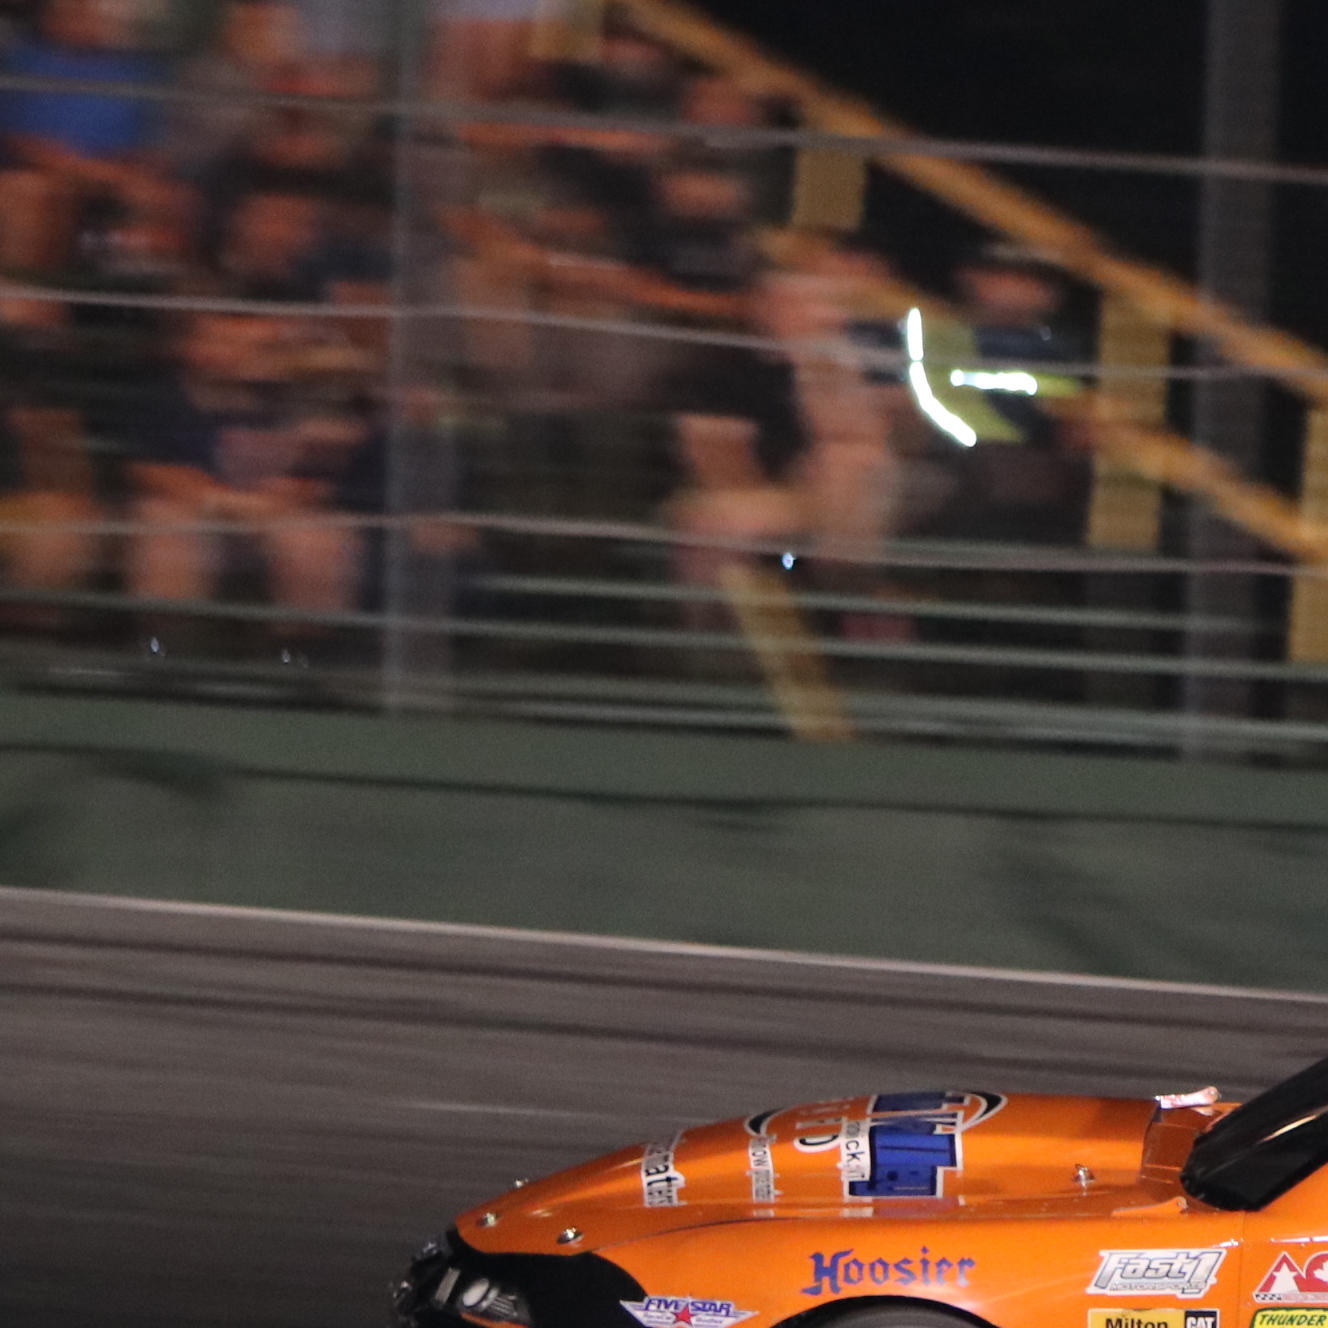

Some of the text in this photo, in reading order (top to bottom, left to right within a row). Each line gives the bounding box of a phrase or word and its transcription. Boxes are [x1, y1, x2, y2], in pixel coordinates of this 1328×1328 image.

[801, 1245, 976, 1296] Hoosier
[690, 1301, 732, 1317] STAR
[1259, 1314, 1327, 1326] THUNDER
